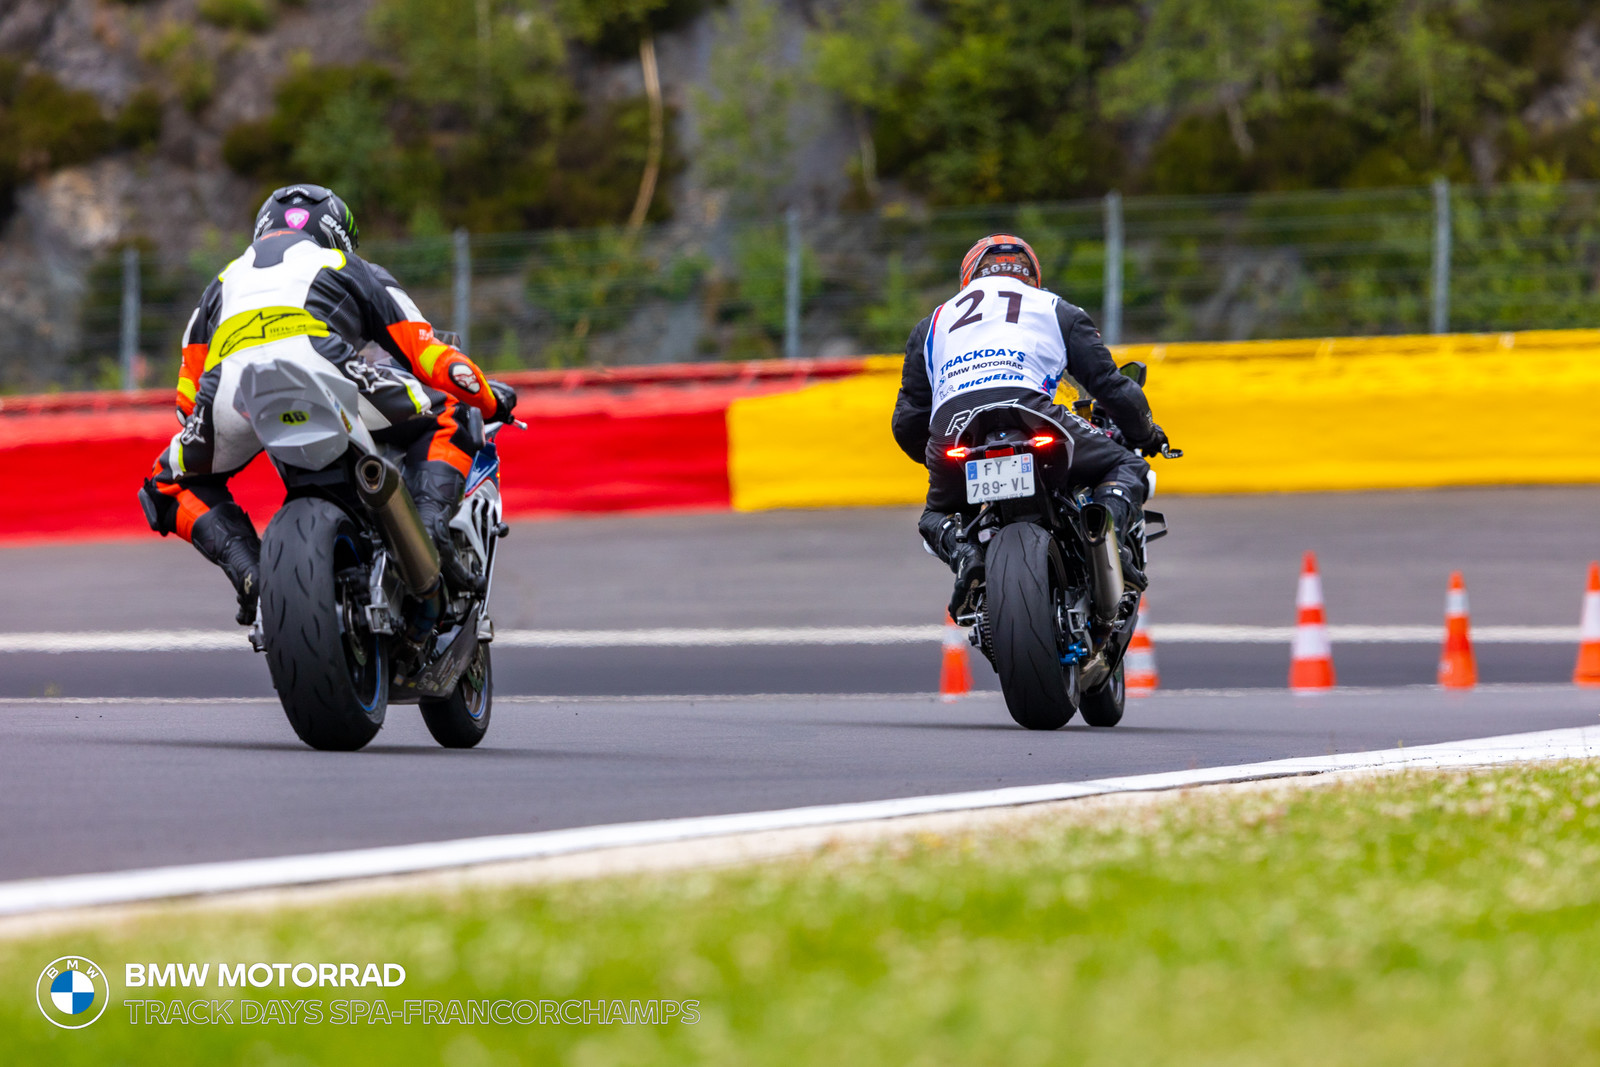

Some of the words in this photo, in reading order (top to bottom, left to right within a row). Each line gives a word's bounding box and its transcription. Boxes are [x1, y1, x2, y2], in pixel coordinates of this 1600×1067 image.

[981, 262, 1030, 277] RODEO
[948, 289, 1023, 334] 21
[940, 348, 1026, 376] TRACKDAYS
[947, 366, 970, 379] BMW
[972, 360, 1024, 370] MOTORRAD
[957, 373, 1024, 391] MICHELIN
[282, 411, 307, 424] 46
[1022, 464, 1031, 472] 91
